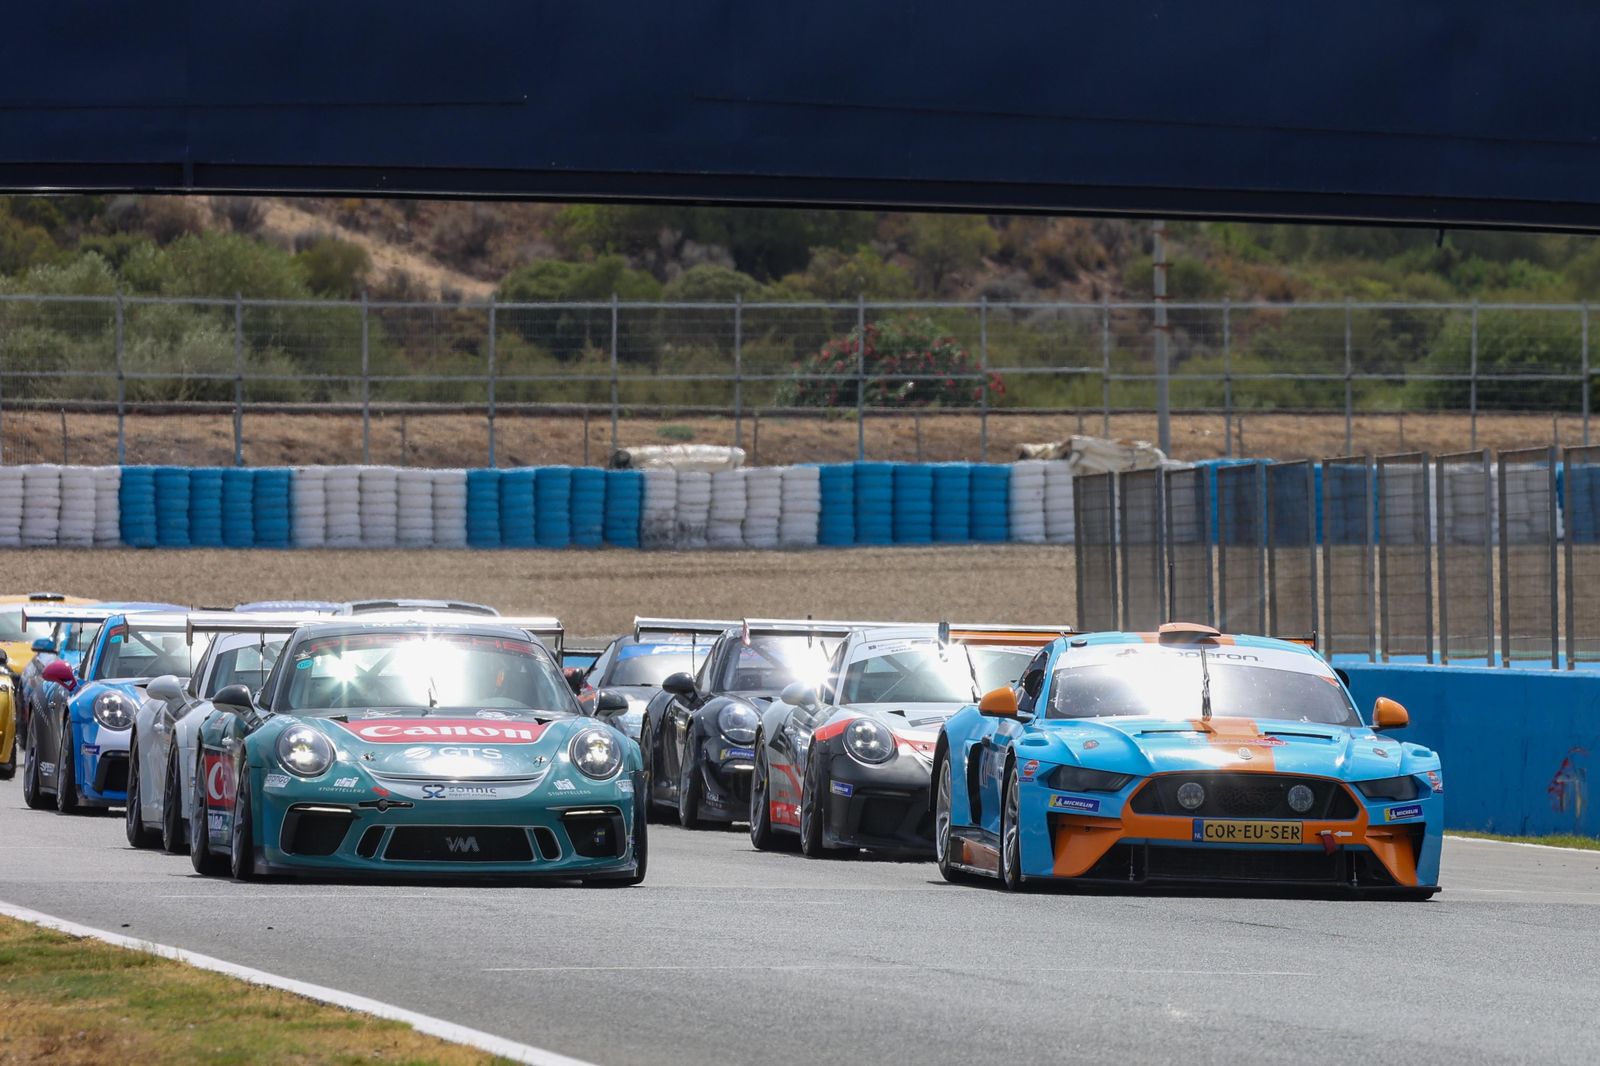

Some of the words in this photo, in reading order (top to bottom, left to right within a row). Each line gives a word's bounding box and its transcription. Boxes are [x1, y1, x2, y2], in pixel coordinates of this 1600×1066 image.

[359, 725, 533, 740] Canon
[438, 747, 504, 760] GTS
[1063, 800, 1095, 809] MICHELIN
[1205, 823, 1301, 840] COR-EU-SER
